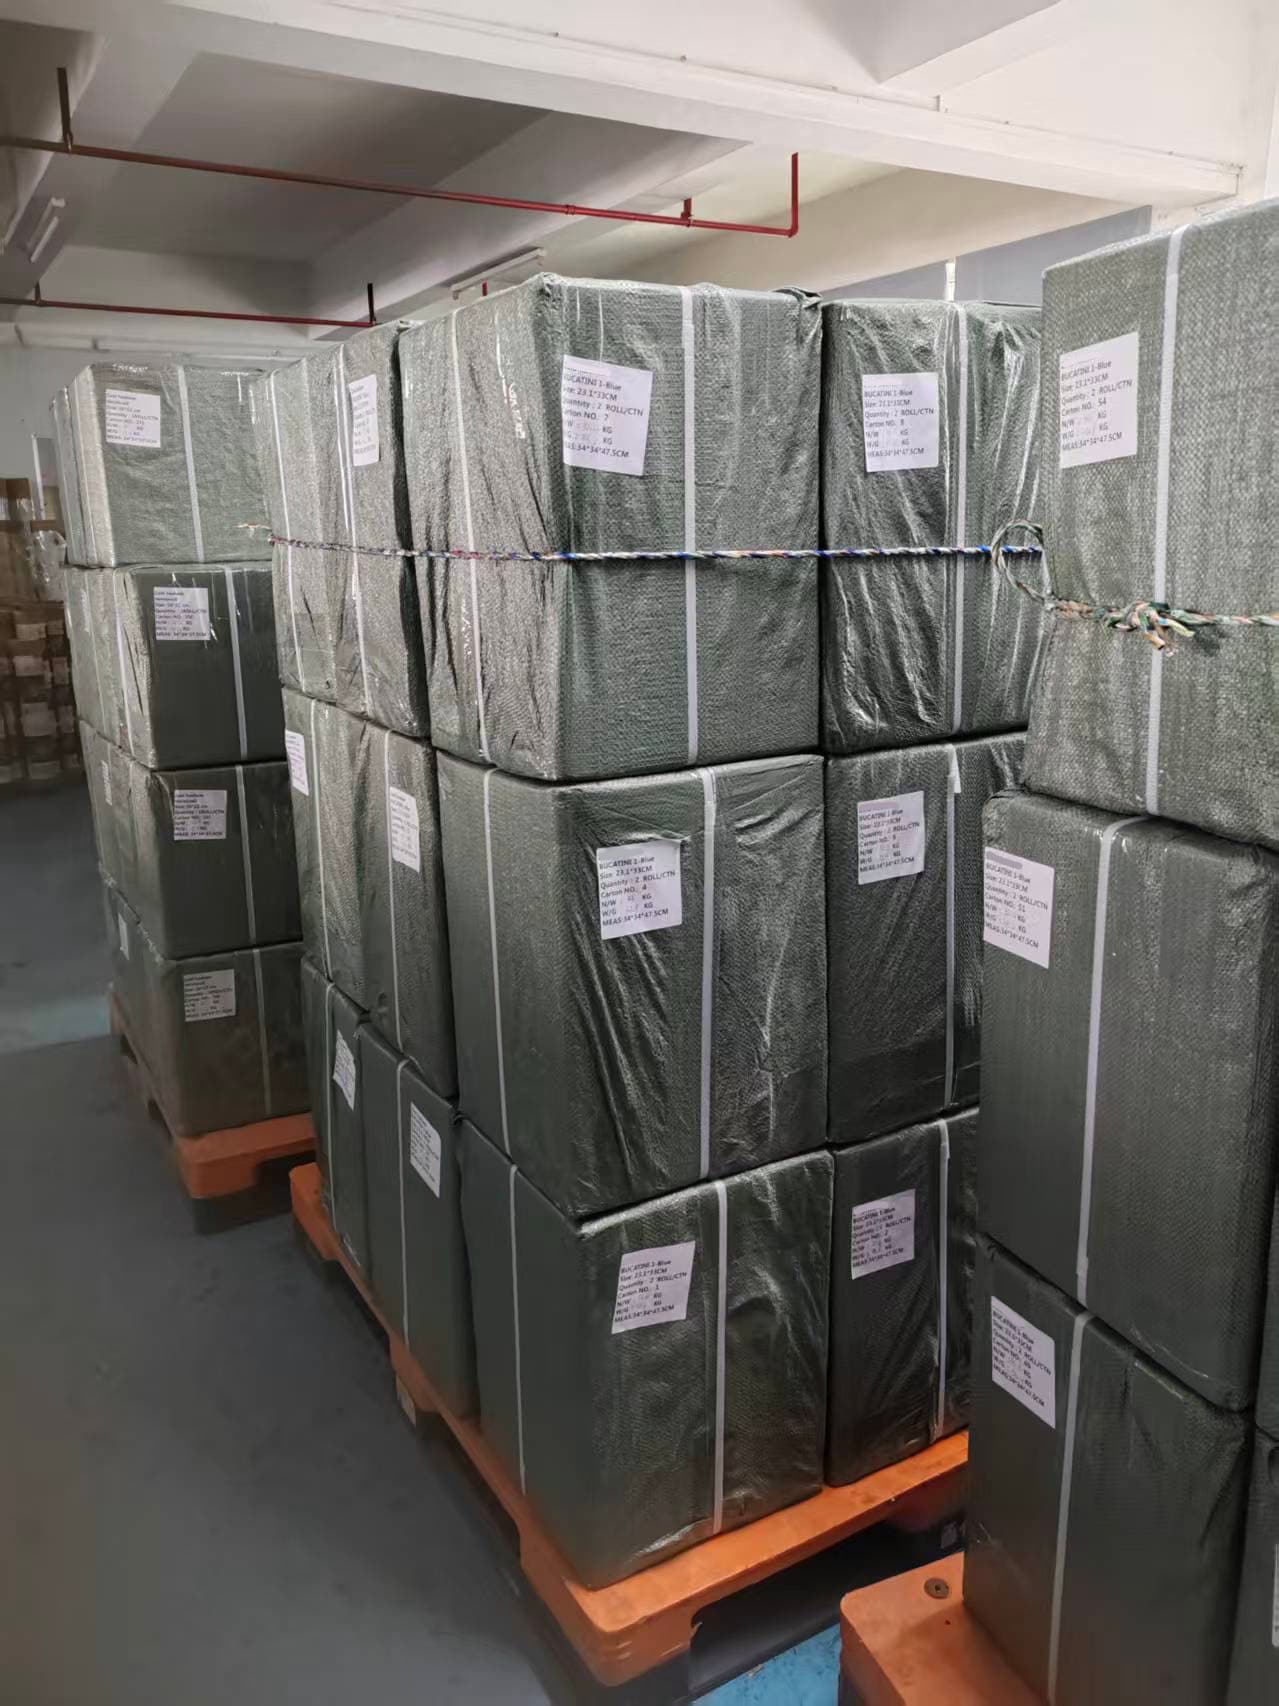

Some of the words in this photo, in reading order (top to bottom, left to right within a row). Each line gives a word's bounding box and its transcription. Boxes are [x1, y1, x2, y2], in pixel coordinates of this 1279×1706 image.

[1062, 366, 1090, 382] BUCATINI
[1091, 360, 1112, 372] 1-Blue
[864, 390, 892, 398] BUCATINI
[1062, 394, 1086, 406] Quantity
[1099, 380, 1132, 394] ROLL/CTN
[606, 404, 644, 416] ROLL/CTN
[1062, 406, 1080, 416] Carton
[1098, 396, 1106, 406] 54
[864, 411, 890, 420] Quantity
[901, 408, 934, 416] ROLL/CTN
[1062, 418, 1074, 429] N/W
[1098, 410, 1106, 418] KG
[602, 426, 612, 434] KG
[1100, 422, 1108, 430] KG
[602, 438, 612, 446] KG
[860, 830, 882, 840] Quantity
[893, 822, 920, 831] ROLL/CTN
[600, 860, 632, 870] BUCATINI
[634, 856, 654, 864] 1-Blue
[986, 862, 1012, 878] BUCATINI
[600, 880, 628, 890] Quantity
[643, 870, 676, 880] ROLL/CTN
[601, 890, 622, 898] Carton
[986, 882, 1008, 896] Quantity
[1020, 894, 1048, 910] ROLL/CTN
[602, 898, 616, 907] N/W
[602, 908, 616, 916] W/G
[1017, 914, 1026, 923] KG
[1018, 926, 1026, 934] KG
[621, 1263, 650, 1273] BUCATINI
[620, 1280, 644, 1291] Quantity
[658, 1272, 688, 1281] ROLL/CTN
[618, 1289, 638, 1298] Carton
[1024, 1352, 1052, 1376] ROLL/CTN
[1024, 1370, 1032, 1380] KG
[1024, 1379, 1032, 1390] KG
